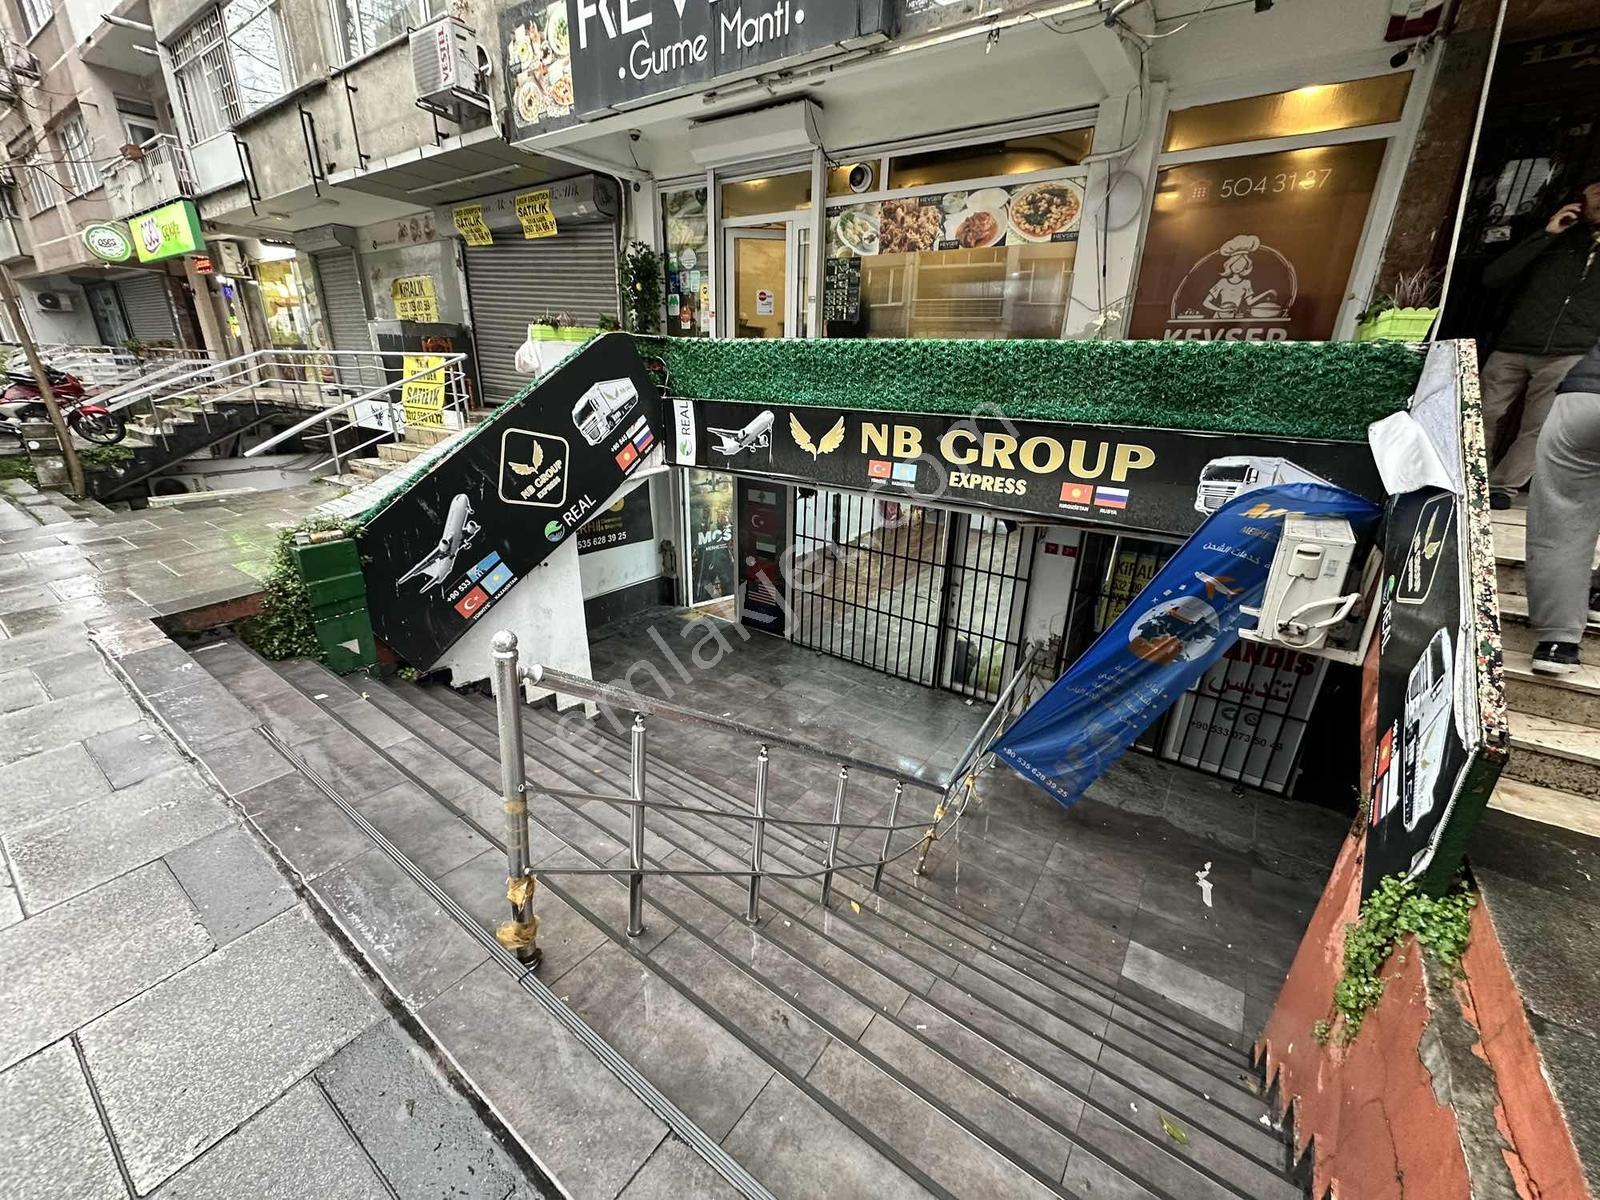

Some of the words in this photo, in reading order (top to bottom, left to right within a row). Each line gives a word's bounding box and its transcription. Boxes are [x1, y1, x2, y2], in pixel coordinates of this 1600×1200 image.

[629, 34, 708, 80] Gurme
[1219, 176, 1268, 198] 504
[517, 201, 549, 218] SATILIK
[680, 401, 691, 436] REAL
[861, 422, 923, 459] NB
[940, 428, 1156, 482] GROUP
[520, 484, 536, 500] NB
[534, 459, 562, 488] GROUP
[949, 471, 1028, 496] EXPRESS
[562, 494, 597, 527] REAL
[592, 537, 606, 546] 628
[607, 534, 617, 544] 39
[617, 531, 627, 541] 25
[1202, 541, 1232, 554] الشحن
[447, 590, 460, 602] +90
[458, 579, 472, 592] 533
[1222, 640, 1315, 676] ANDIS
[1192, 720, 1208, 731] +90
[1210, 724, 1229, 737] 533
[1003, 747, 1016, 759] +90
[1016, 757, 1031, 770] 535
[1031, 768, 1047, 781] 628
[1046, 778, 1057, 789] 39
[1057, 787, 1069, 798] 25
